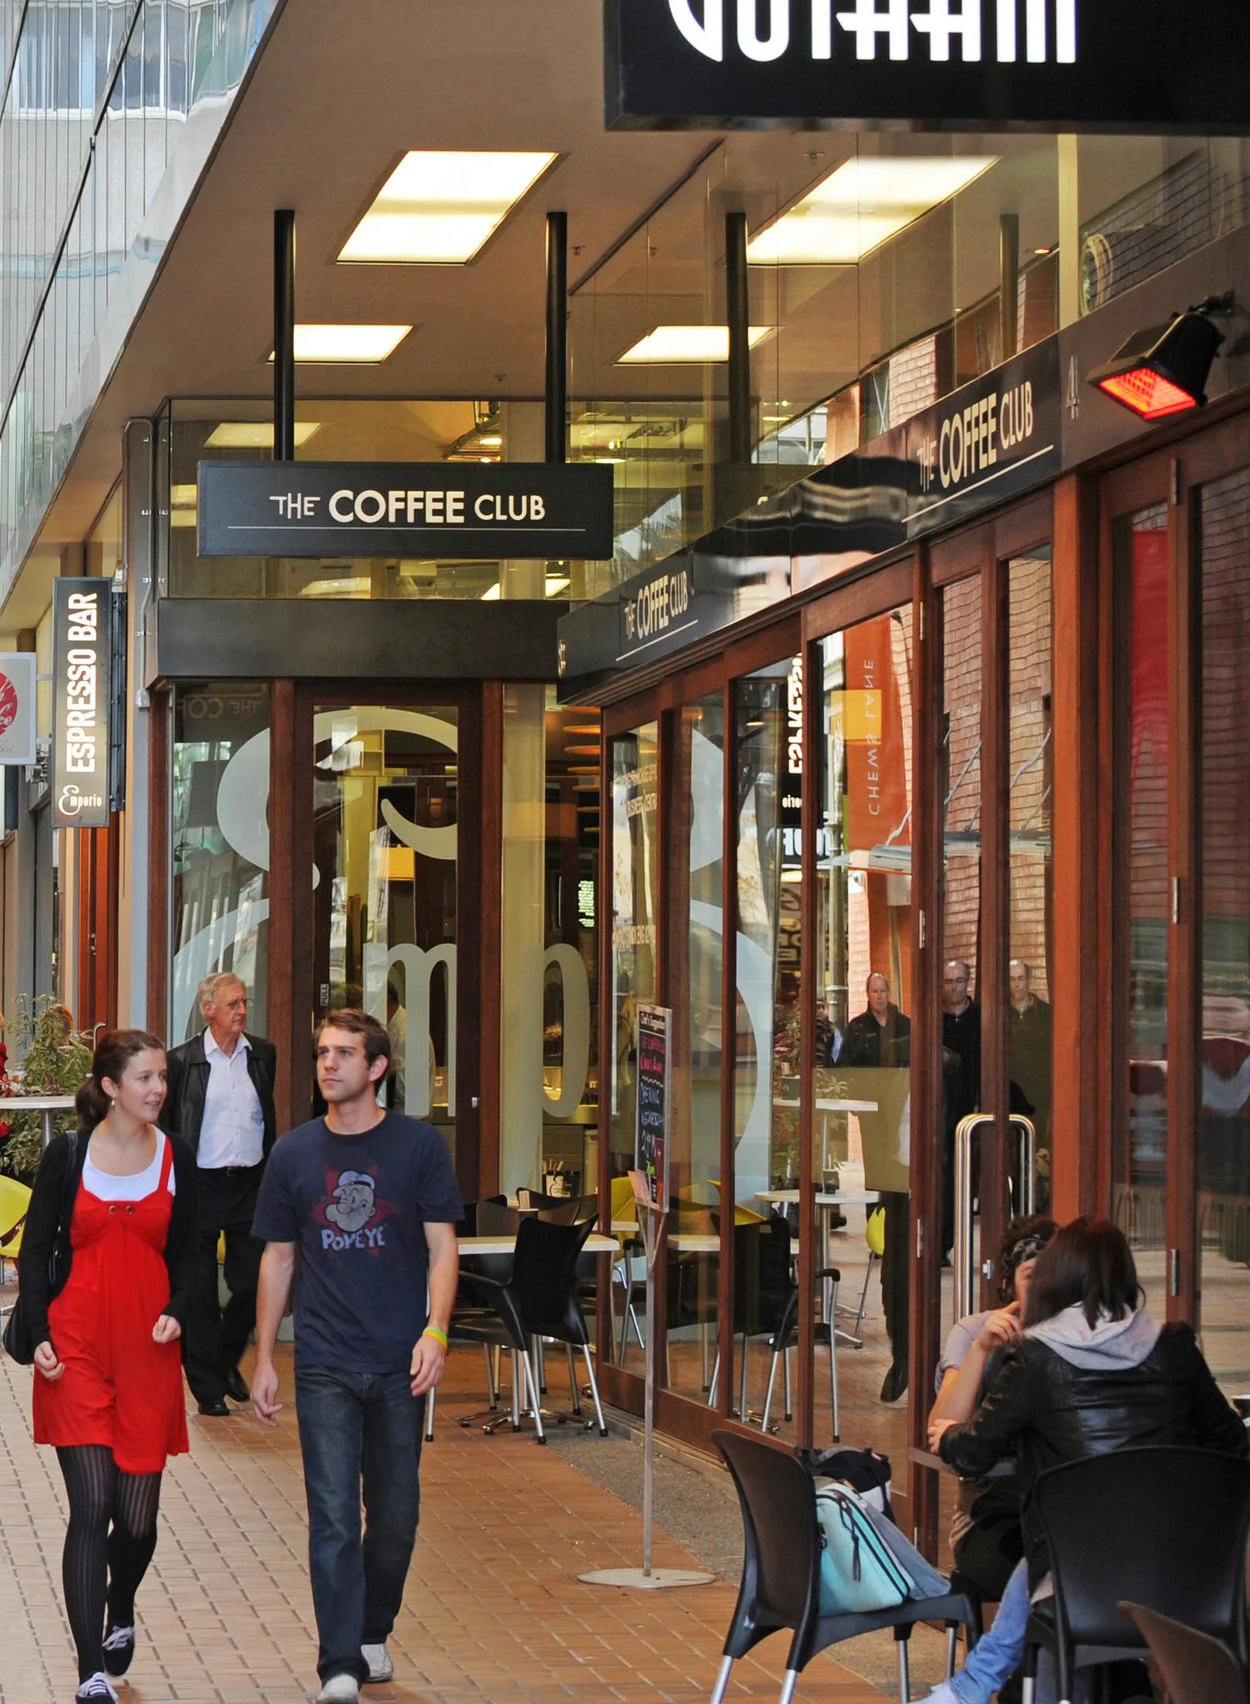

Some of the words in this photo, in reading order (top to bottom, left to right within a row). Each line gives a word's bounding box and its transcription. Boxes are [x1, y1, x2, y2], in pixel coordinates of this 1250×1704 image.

[916, 436, 937, 492] THE
[939, 392, 997, 488] COFFEE
[1000, 381, 1034, 450] CLUB
[269, 493, 321, 519] THE
[328, 490, 465, 523] COFFEE
[474, 495, 546, 520] CLUB
[68, 593, 98, 641] BAR
[637, 575, 669, 639] COFFEE
[670, 571, 688, 617] CLUB
[67, 649, 97, 773] ESPRESSO
[58, 784, 102, 815] Emporio
[321, 1227, 386, 1251] POPEYE
